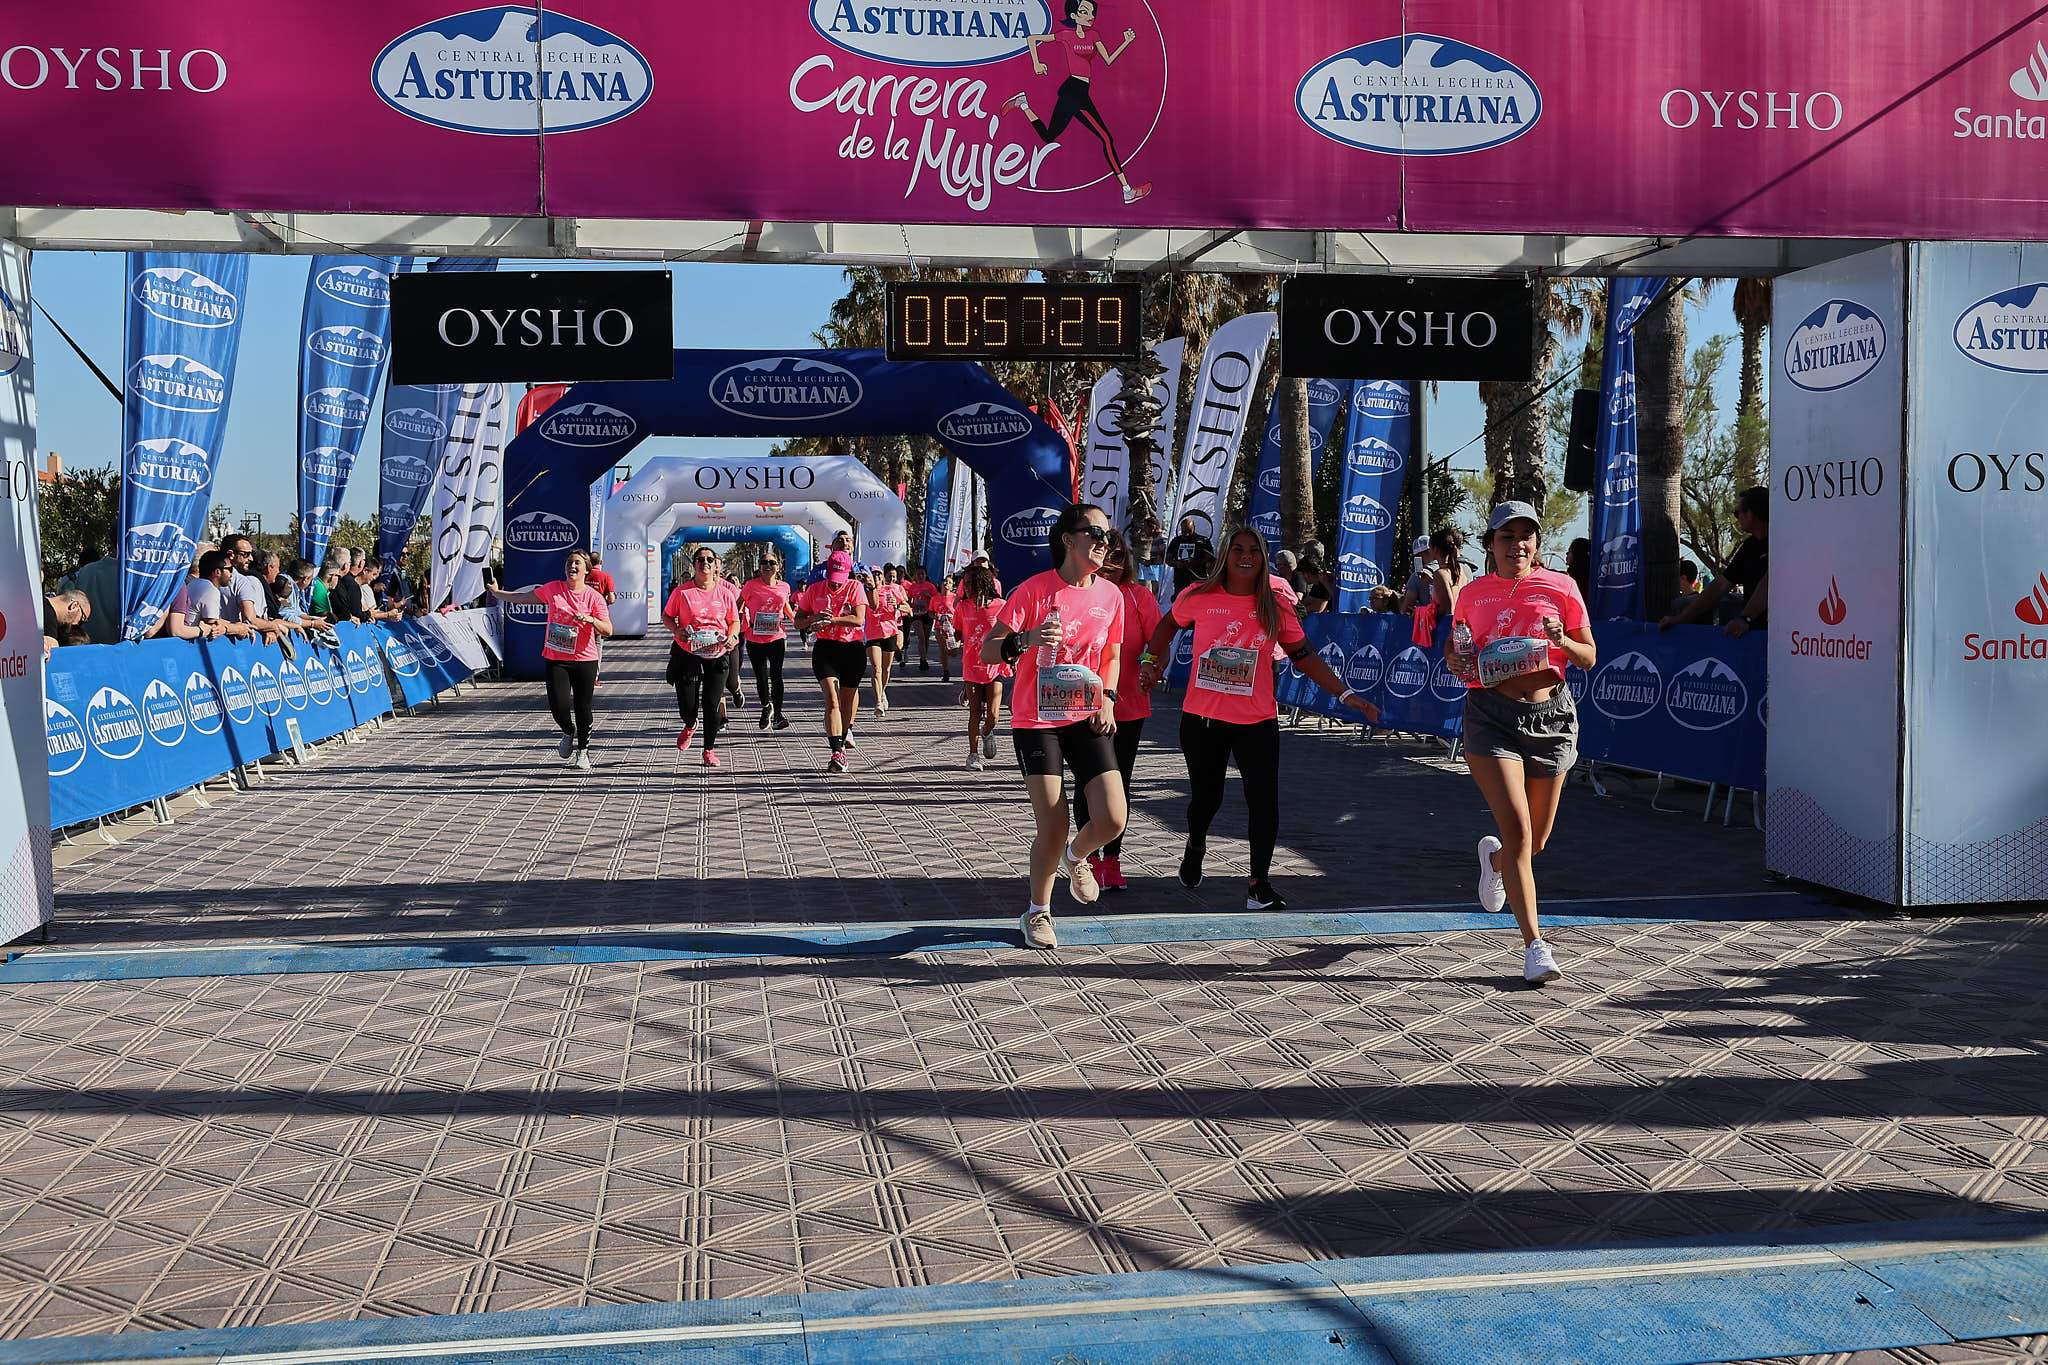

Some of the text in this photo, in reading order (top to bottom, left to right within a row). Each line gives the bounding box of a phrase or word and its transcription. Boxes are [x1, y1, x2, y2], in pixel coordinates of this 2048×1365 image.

[829, 0, 1030, 39] ASTURIANA
[1, 46, 227, 93] OYSHO
[437, 49, 524, 63] CENTRAL
[394, 51, 633, 102] ASTURIANA
[789, 55, 988, 119] Carrera
[1353, 74, 1516, 90] CENTRAL LECHERA
[1315, 75, 1524, 125] ASTURIANA
[1660, 89, 1843, 131] OYSHO
[1953, 107, 2048, 139] Santa
[838, 114, 1062, 211] de la Mujer
[140, 278, 233, 321] ASTURIANA
[153, 279, 190, 294] CENTRAL
[322, 274, 390, 301] ASTURIAN
[438, 308, 634, 347] OYSHO
[905, 295, 1122, 346] 00:57:29
[1324, 309, 1497, 347] OYSHO
[1966, 316, 2048, 351] ASTUR
[315, 334, 380, 361] ASTURIAN
[1805, 323, 1876, 346] CENTRAL LECHERA
[1790, 336, 1879, 374] ASTURIANA
[148, 368, 183, 381] CENTRAL
[745, 375, 847, 383] CENTRAL LECHERA
[720, 376, 852, 405] ASTURIANA
[1358, 391, 1410, 413] ASTURIANA
[308, 397, 368, 421] ASTURIAN
[545, 419, 629, 437] ASTURIANA
[945, 420, 1026, 437] ASTURIANA
[128, 453, 202, 485] ASTURIA
[142, 453, 204, 468] CENTRAL LECH
[1947, 452, 2048, 493] OYS
[694, 466, 816, 490] OYSHO
[1784, 457, 1884, 502] OYSHO
[622, 494, 659, 502] OYSHO
[848, 491, 885, 499] OYSHO
[508, 526, 574, 543] ASTURIANA
[1006, 523, 1051, 538] ASTURI
[606, 543, 641, 551] OYSHO
[868, 540, 901, 549] OYSHO
[613, 591, 641, 600] YSHO
[1791, 630, 1873, 661] Santander
[1963, 633, 2048, 661] Santa
[1388, 665, 1425, 686] ASTURIANA
[1595, 675, 1656, 704] ASTURIANA
[1670, 681, 1737, 715] ASTURIANA
[91, 716, 143, 746] ASTURIANA
[148, 706, 185, 733] ASTURIANA
[47, 730, 85, 756] URIANA
